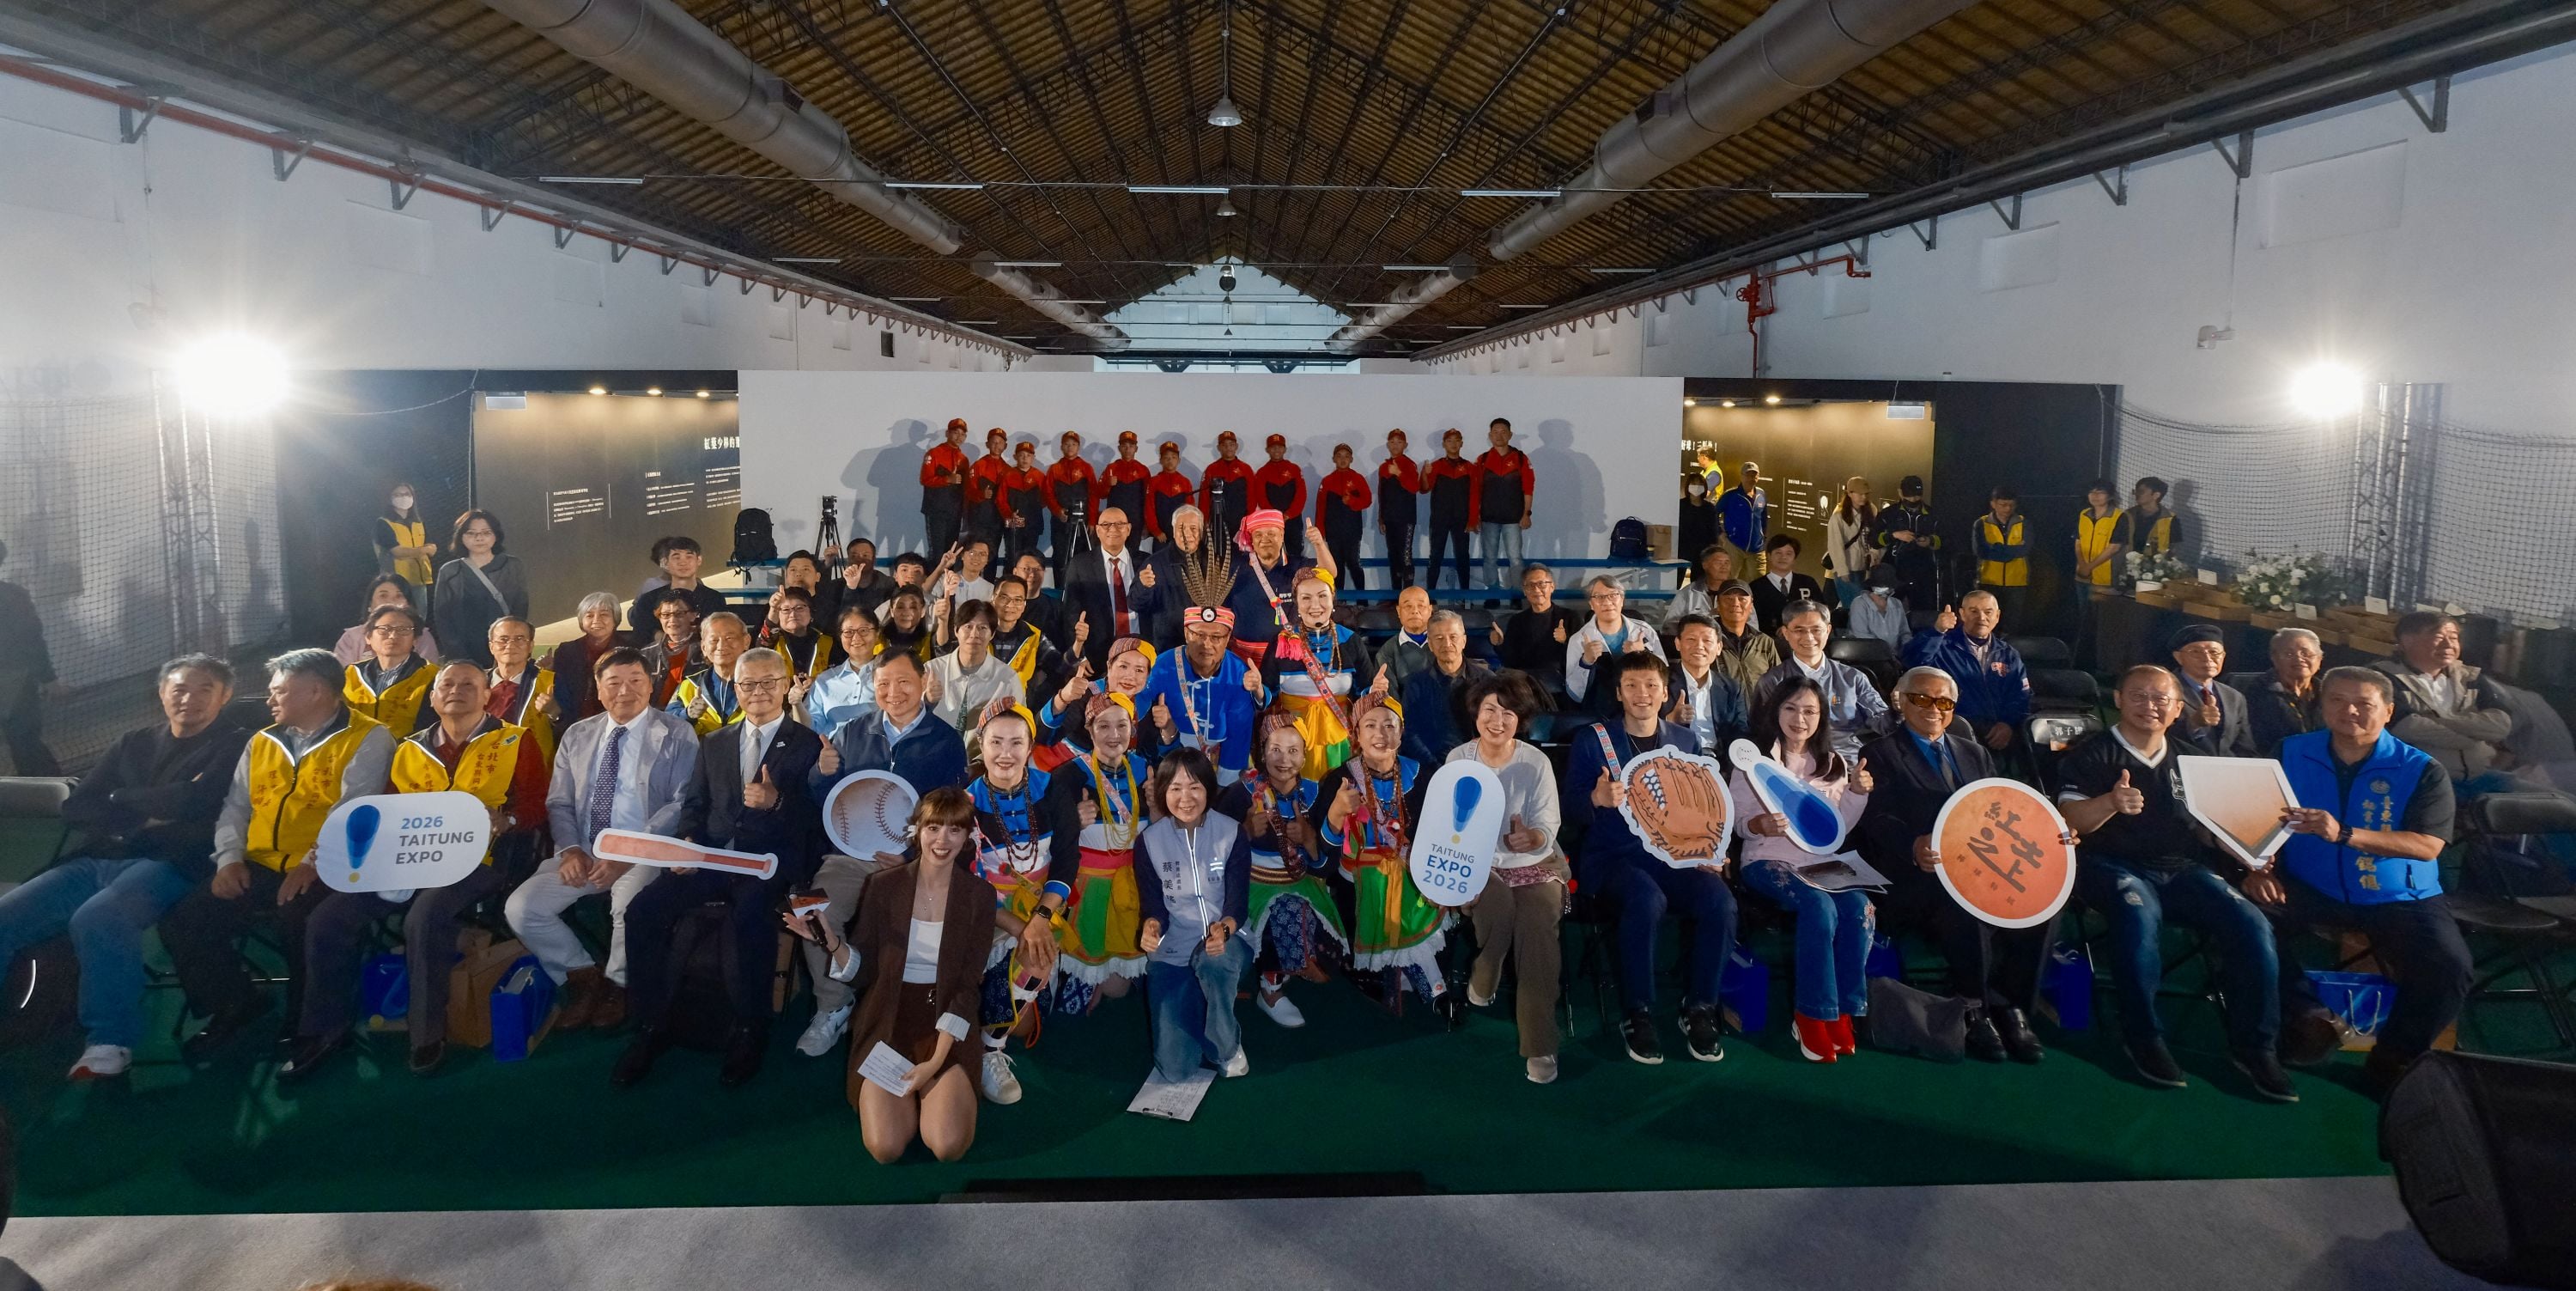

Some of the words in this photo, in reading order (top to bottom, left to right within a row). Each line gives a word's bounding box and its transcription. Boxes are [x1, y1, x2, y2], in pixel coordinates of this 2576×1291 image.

[1799, 588, 1811, 600] P
[485, 741, 501, 775] 台北市
[401, 816, 443, 830] 2026
[399, 831, 474, 847] TAITUNG
[396, 850, 443, 864] EXPO
[1431, 843, 1475, 864] TAITUNG
[1427, 855, 1472, 878] EXPO
[1423, 869, 1468, 894] 2026
